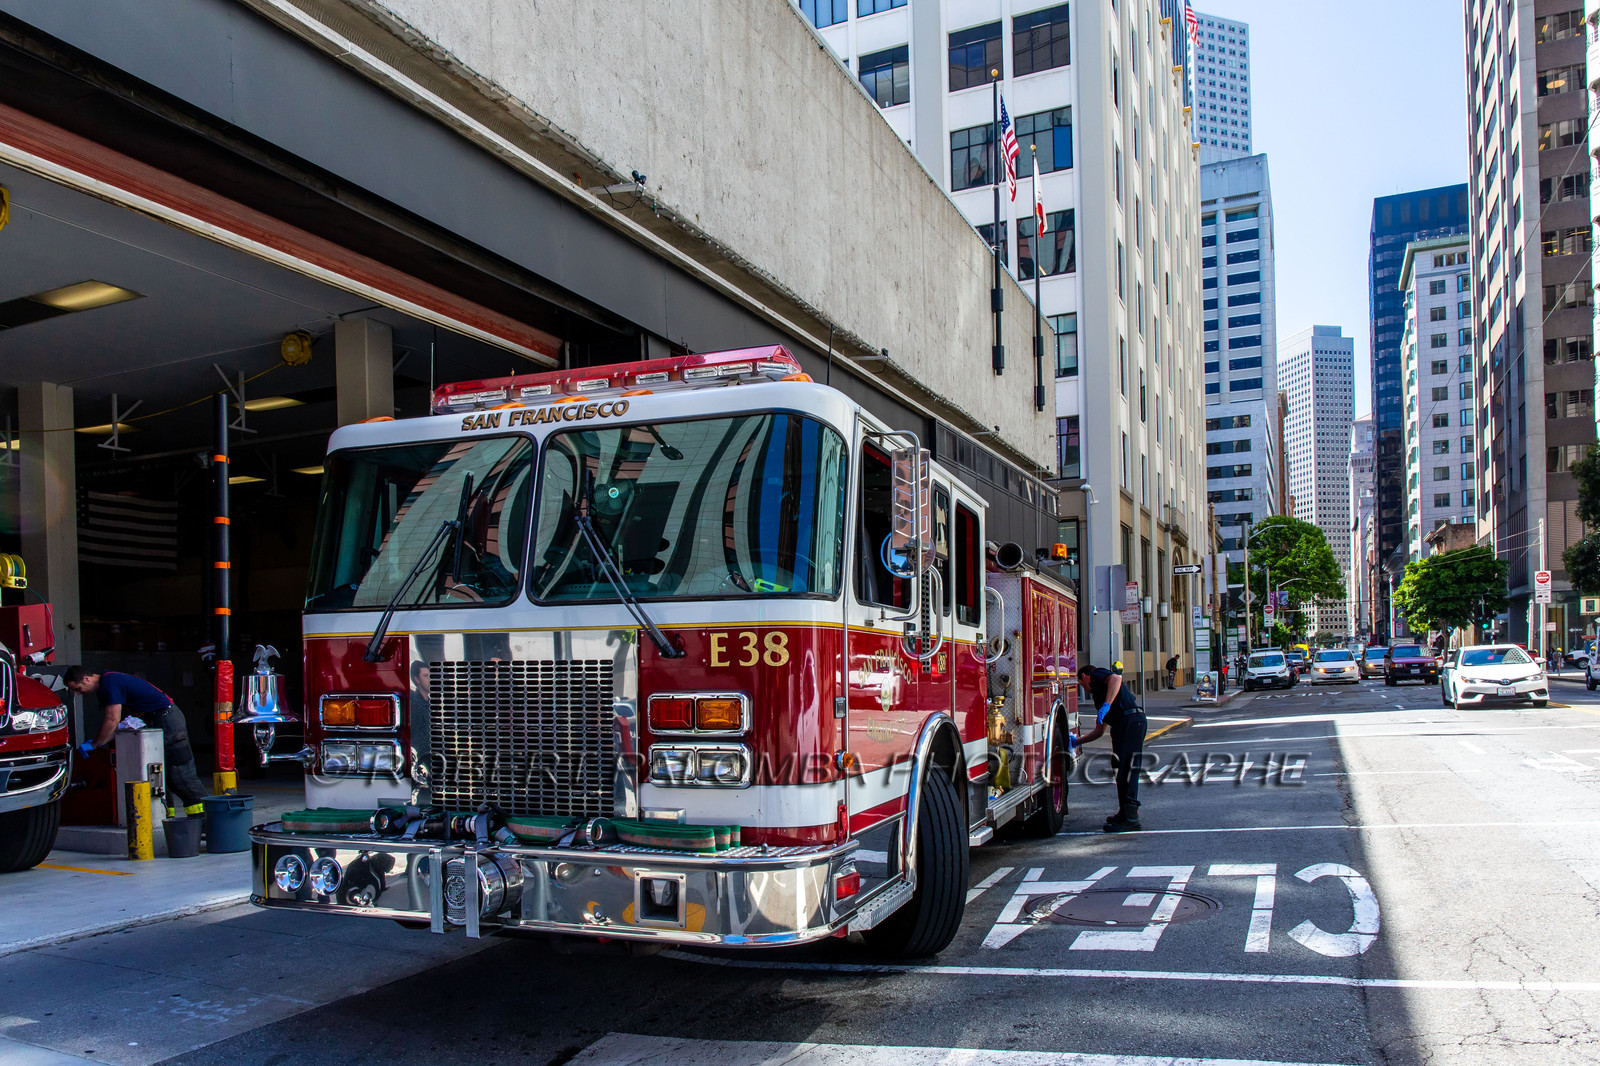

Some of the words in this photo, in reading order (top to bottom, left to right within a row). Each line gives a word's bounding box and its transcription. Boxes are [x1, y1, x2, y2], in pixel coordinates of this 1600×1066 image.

[461, 412, 502, 432] SAN
[508, 399, 630, 427] FRANCISCO
[858, 655, 873, 689] SAN
[874, 648, 912, 686] FRANCISCO
[866, 715, 894, 743] ENGINE
